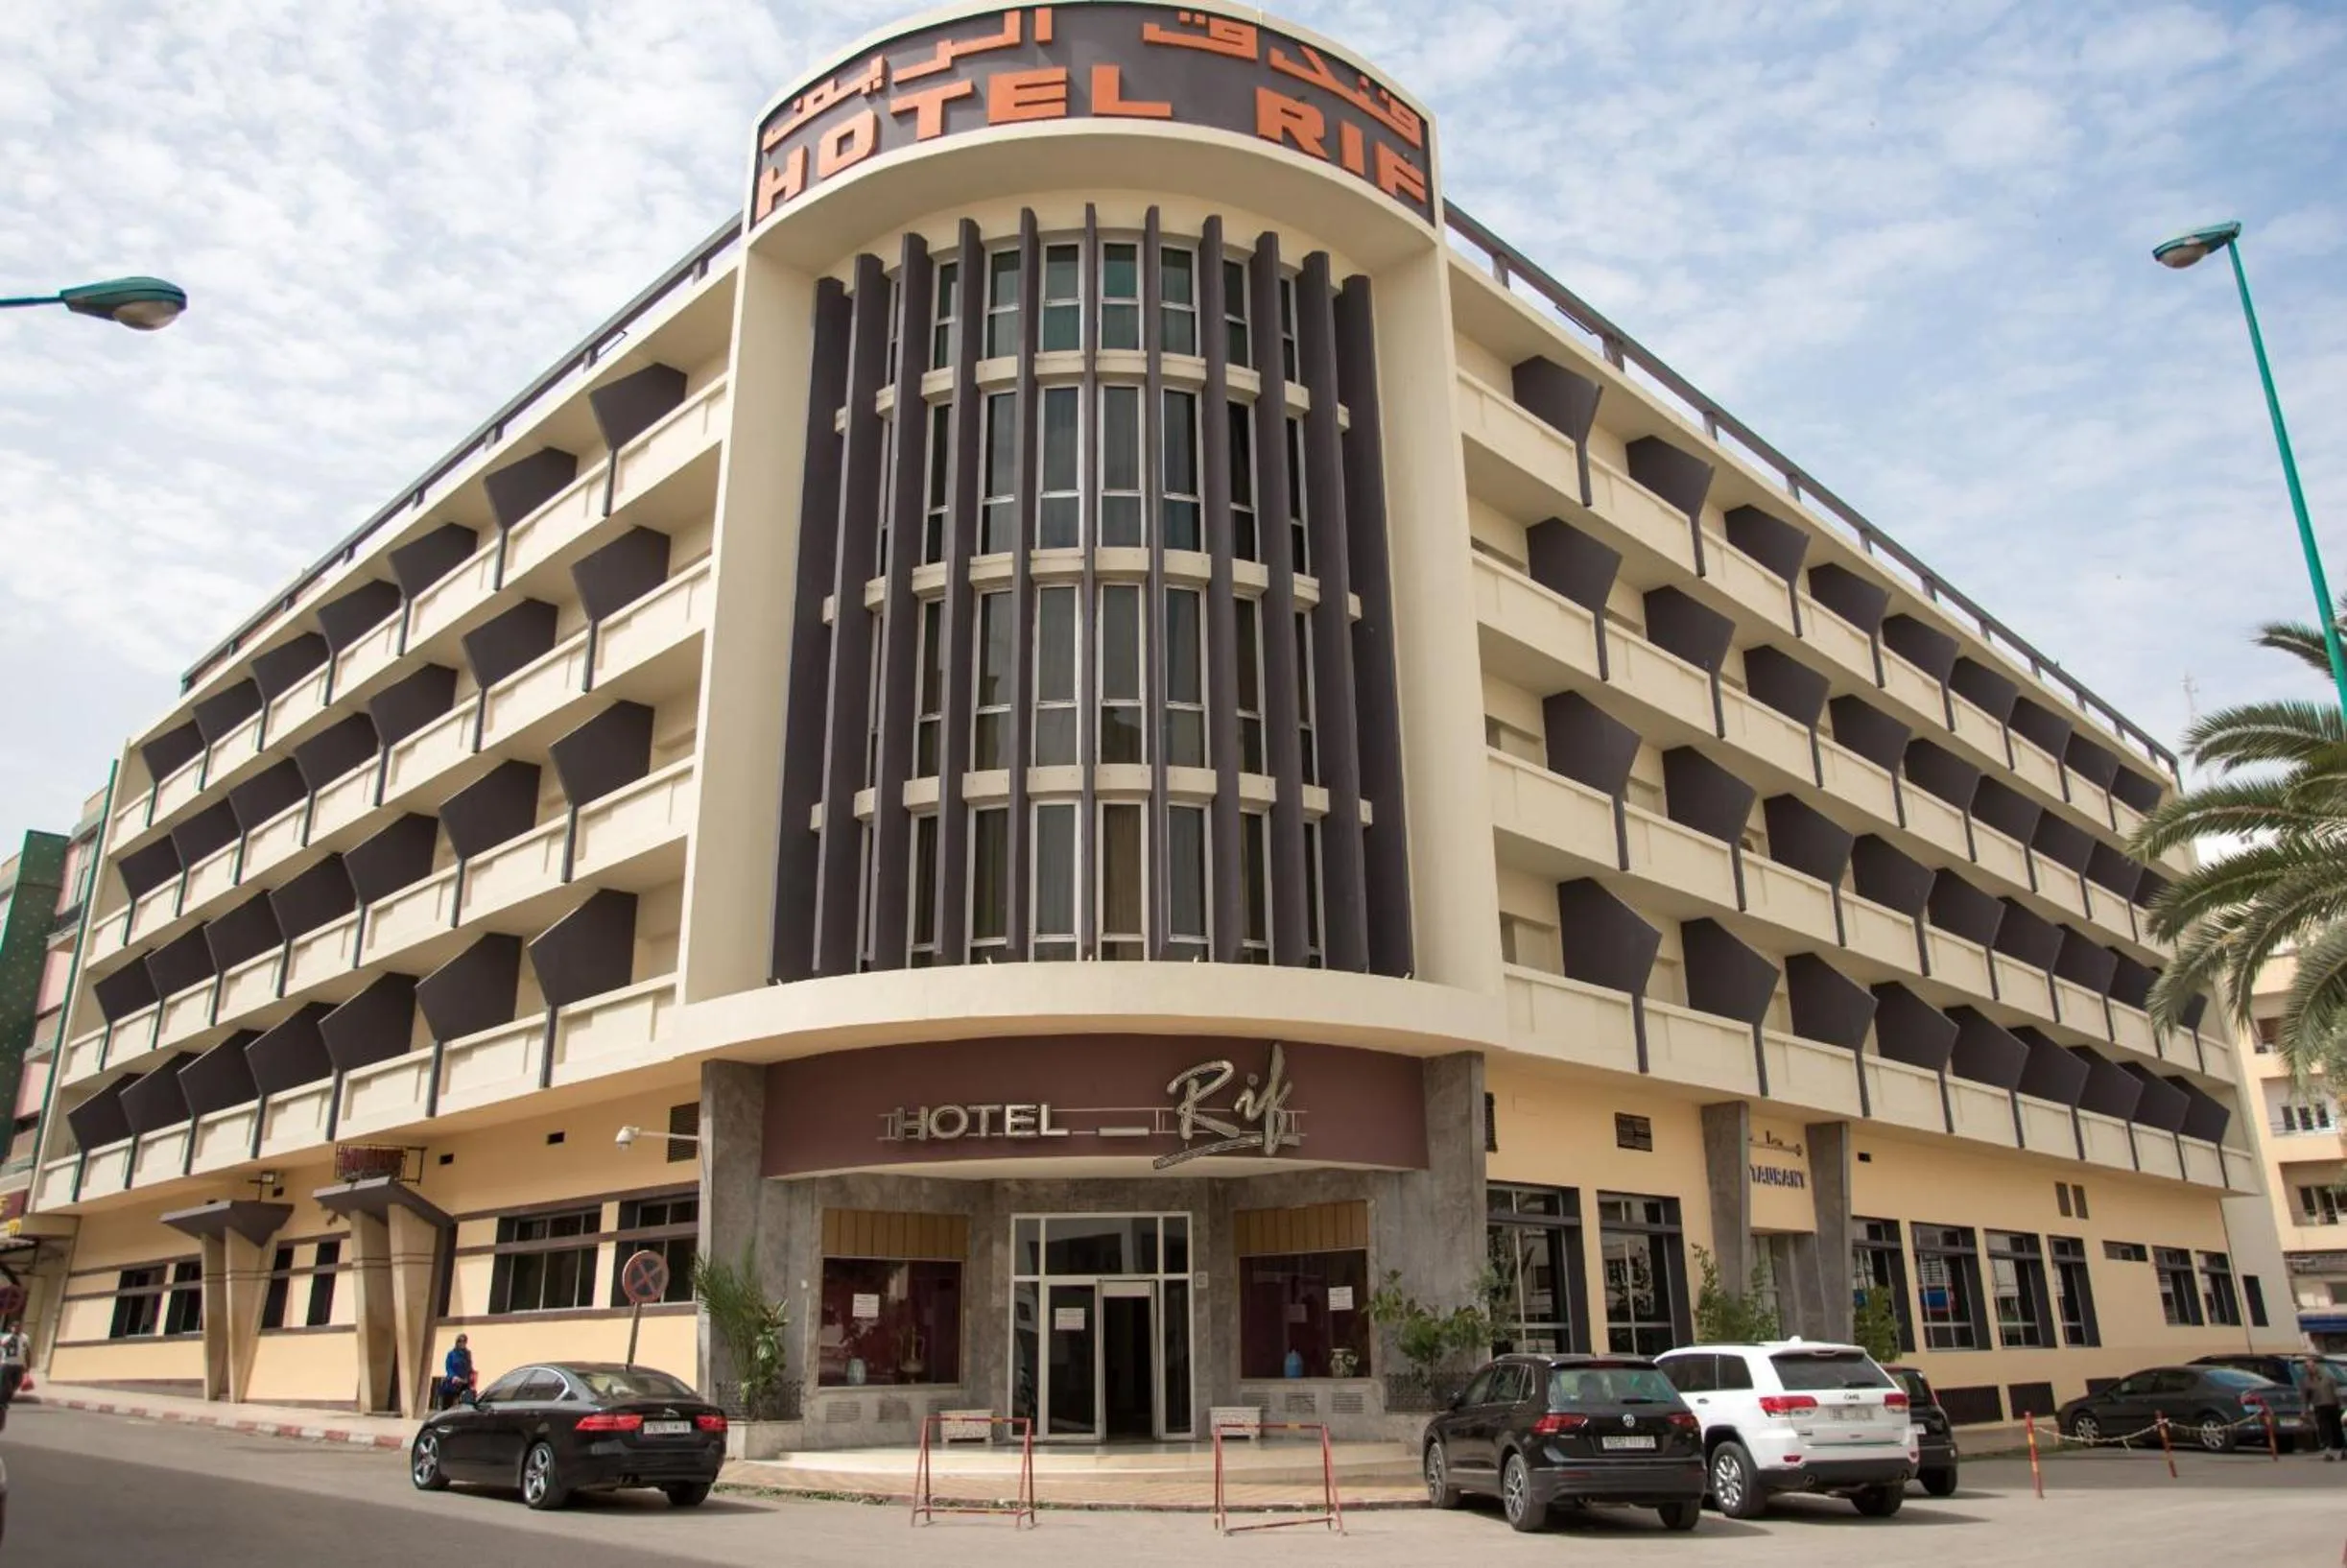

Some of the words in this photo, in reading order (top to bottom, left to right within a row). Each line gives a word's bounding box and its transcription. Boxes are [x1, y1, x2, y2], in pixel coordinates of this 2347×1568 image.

[755, 64, 1173, 224] HOTEL
[1255, 85, 1427, 204] RIF
[762, 7, 1053, 153] الريف
[1142, 11, 1423, 150] فندق
[894, 1102, 1070, 1142] HOTEL
[1166, 1041, 1293, 1157] Rif
